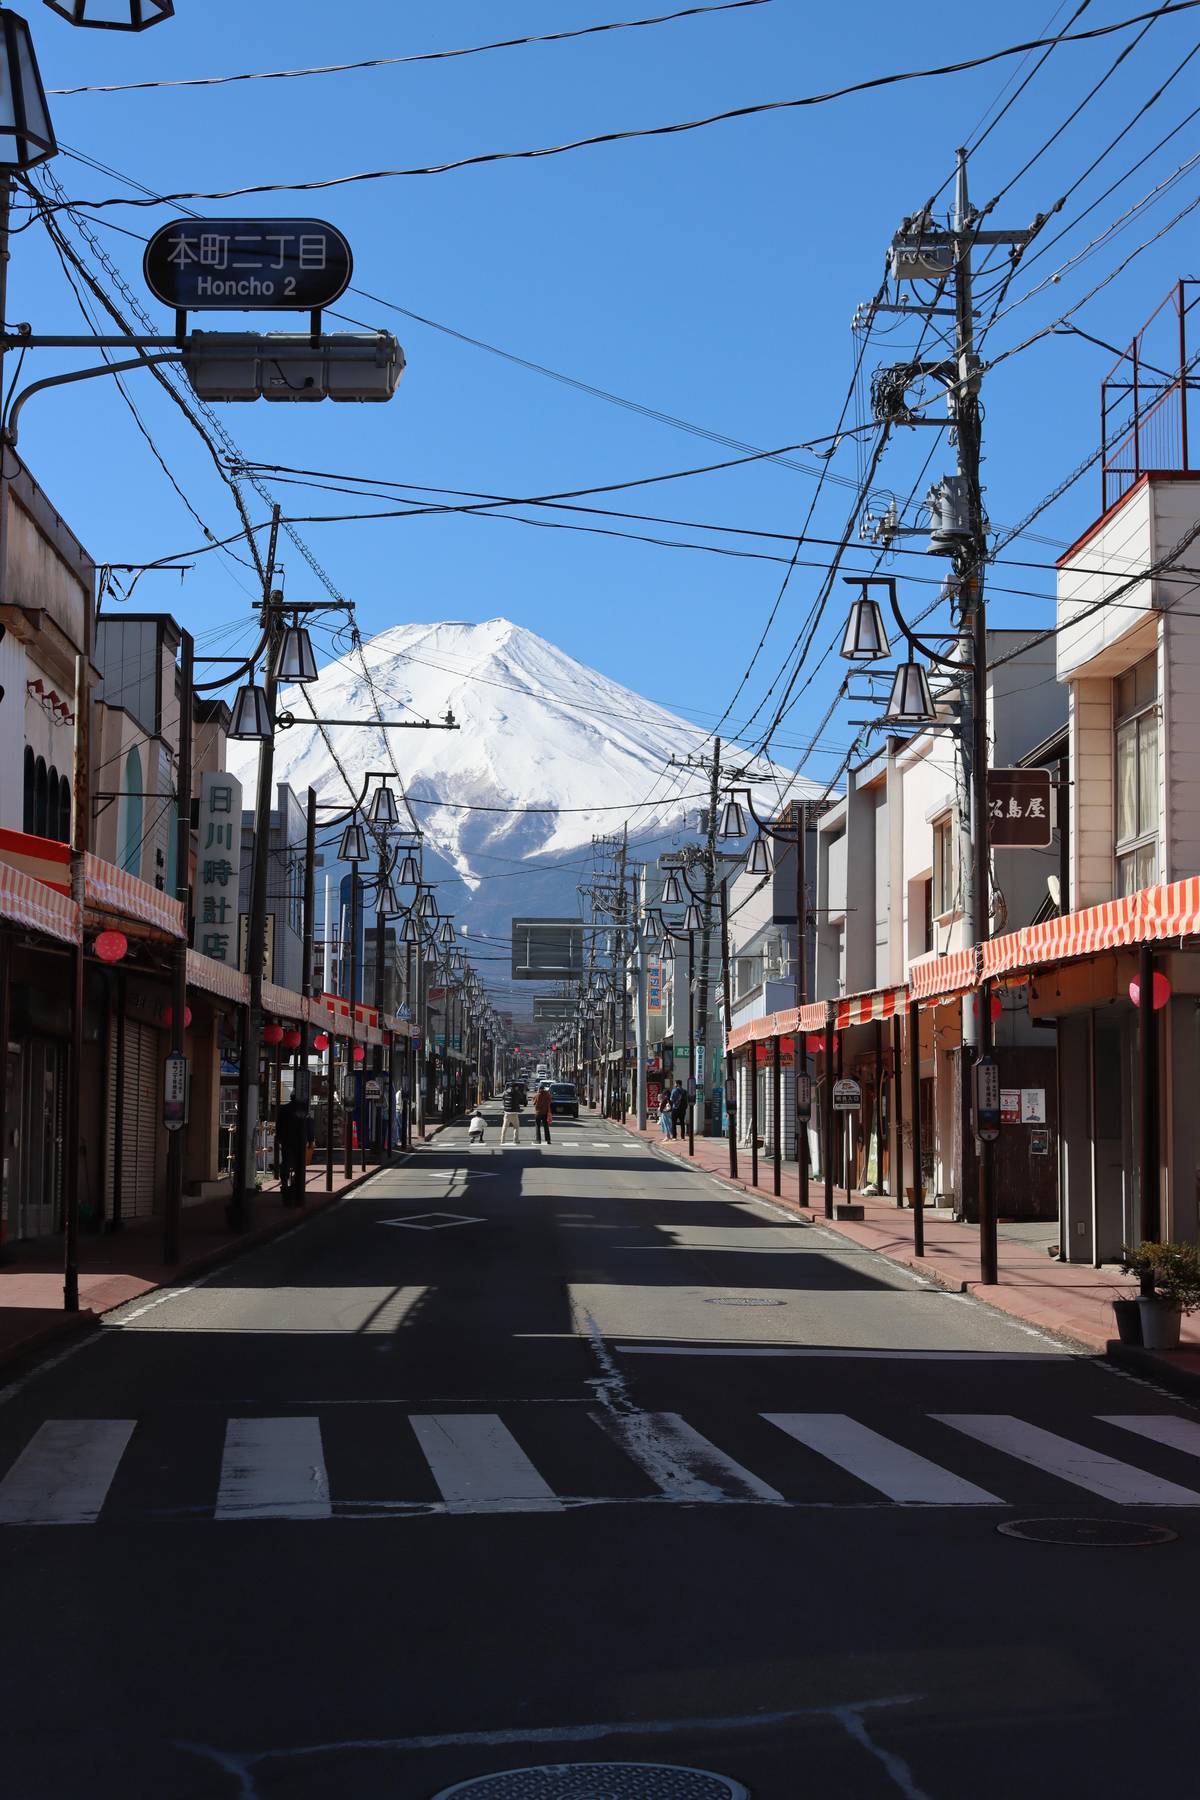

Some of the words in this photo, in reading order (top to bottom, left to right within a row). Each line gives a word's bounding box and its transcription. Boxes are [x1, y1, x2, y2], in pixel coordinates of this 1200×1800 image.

[167, 233, 326, 271] 本町二丁目
[197, 276, 274, 296] Honcho
[283, 276, 296, 296] 2
[203, 786, 233, 961] 日川時計店
